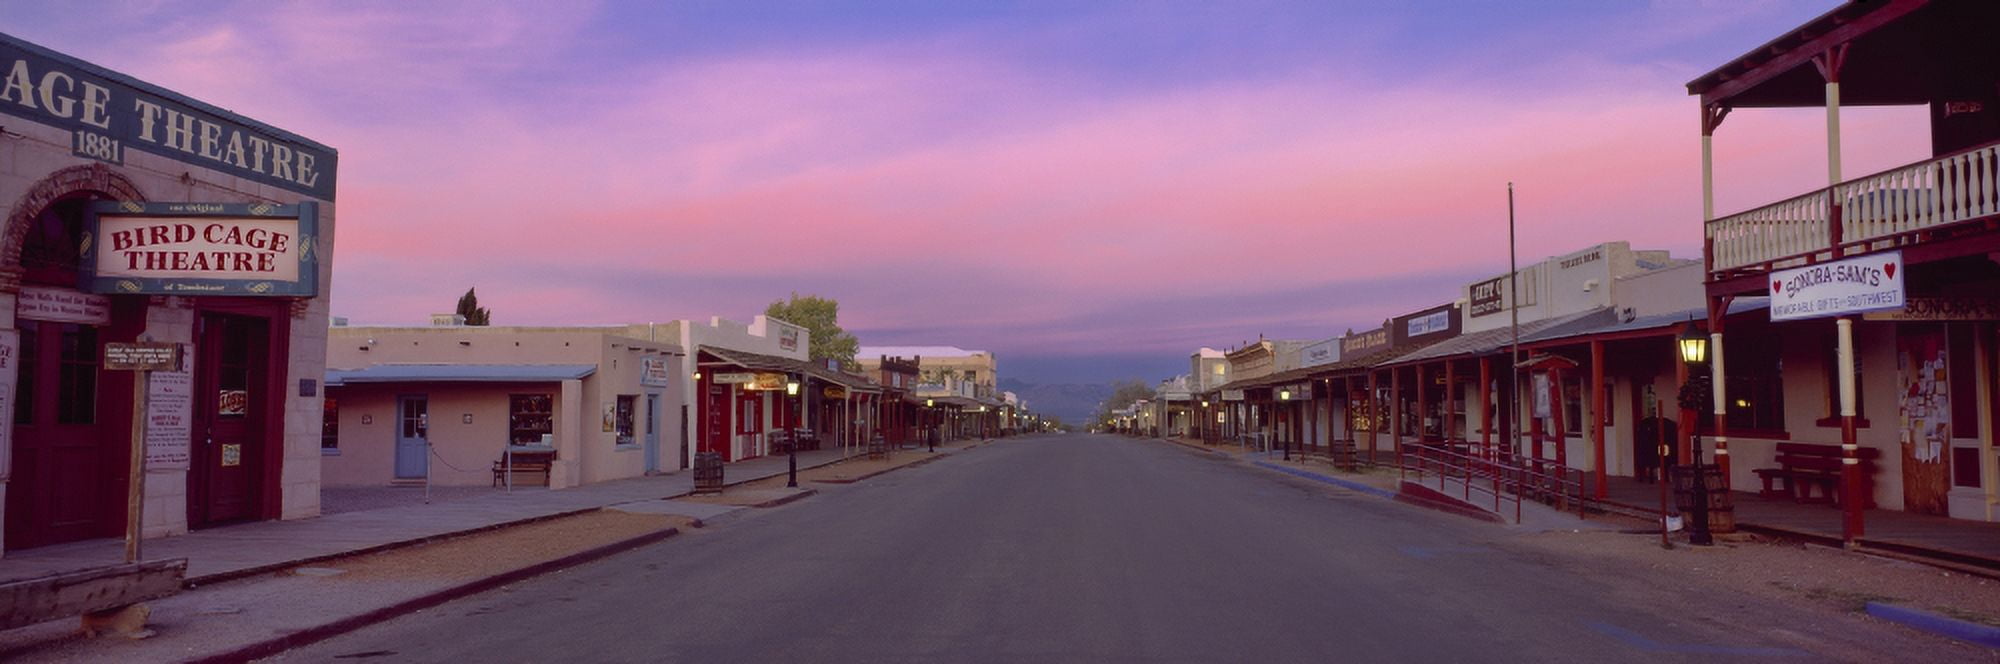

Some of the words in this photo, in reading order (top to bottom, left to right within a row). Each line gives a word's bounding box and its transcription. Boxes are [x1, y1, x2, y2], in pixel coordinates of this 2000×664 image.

[76, 129, 120, 163] 1881
[136, 98, 320, 188] THEATRE
[111, 223, 195, 252] BIRD
[204, 223, 289, 254] CAGE
[124, 250, 275, 272] THEATRE
[1785, 265, 1881, 298] SONORA-SAM'S
[1817, 297, 1839, 311] GIFTS
[1847, 289, 1898, 307] SOUTHWEST
